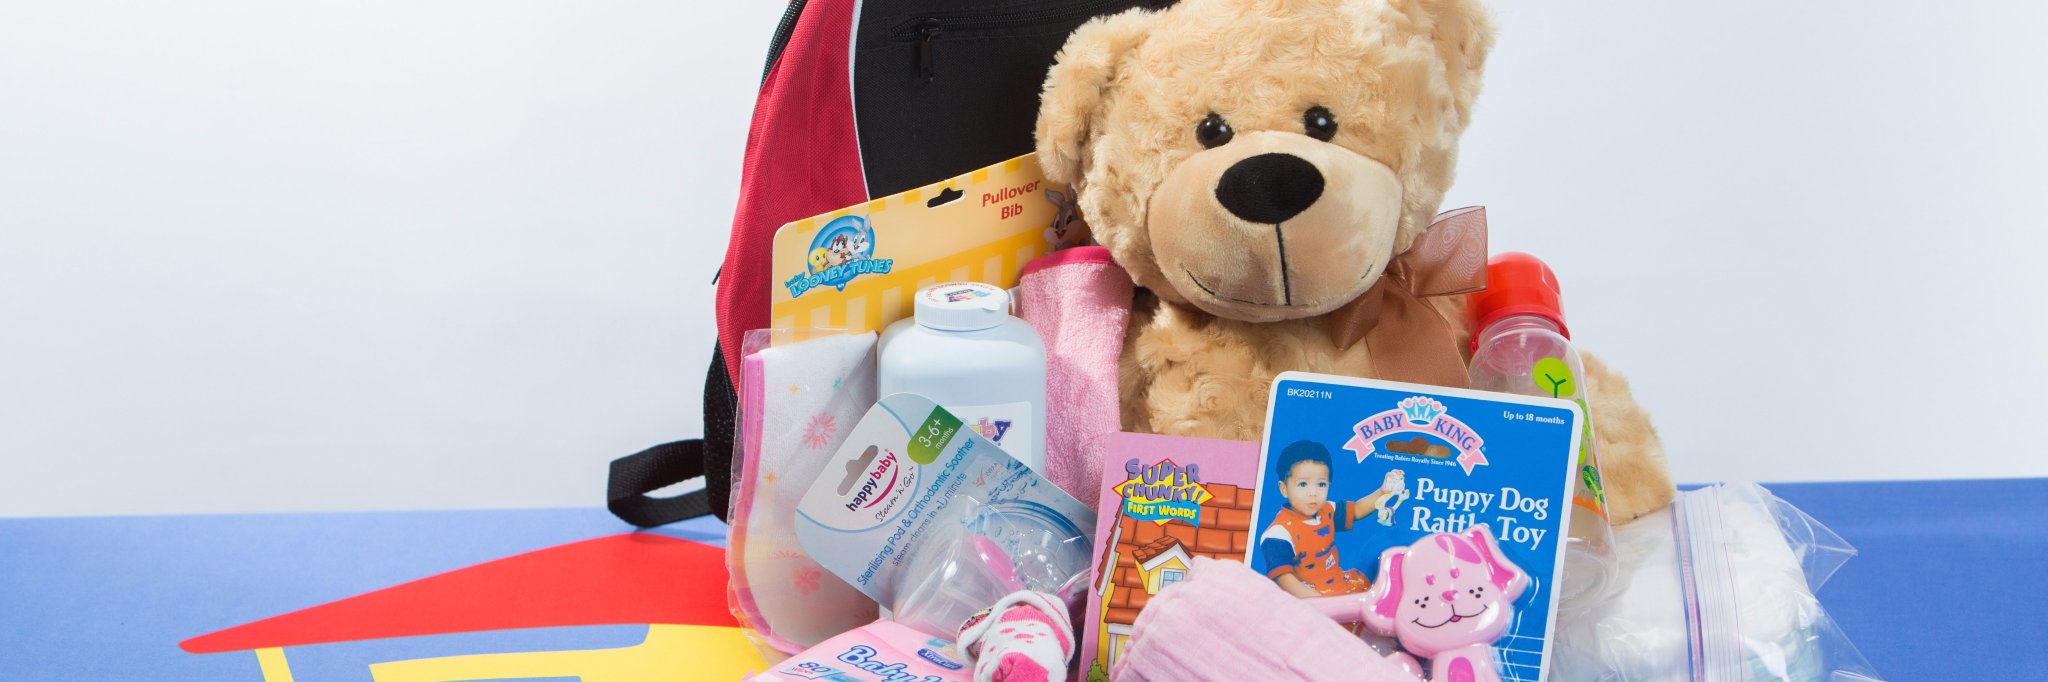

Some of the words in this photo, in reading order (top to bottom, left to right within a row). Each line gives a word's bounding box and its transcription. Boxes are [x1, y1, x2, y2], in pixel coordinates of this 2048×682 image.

[982, 180, 1040, 207] Pullover
[1001, 203, 1023, 220] Bib
[789, 264, 847, 298] LOONEY
[849, 258, 893, 274] TUNES
[1287, 388, 1332, 399] BK20211N
[1503, 410, 1514, 421] Up
[1516, 412, 1524, 420] to
[1526, 413, 1534, 421] 18
[1536, 416, 1565, 425] months
[935, 427, 954, 449] months
[1360, 413, 1403, 440] BABY
[1435, 418, 1476, 451] KING
[1374, 452, 1394, 461] Treating
[1125, 458, 1200, 486] SUPER
[1123, 483, 1205, 504] CHUNKY!
[1415, 477, 1495, 514] Puppy
[1499, 487, 1549, 521] Dog
[857, 543, 894, 586] Sterilising
[888, 526, 906, 546] Pod
[901, 518, 912, 528] &
[908, 470, 951, 519] Orthodontic
[946, 438, 975, 471] Soother
[875, 495, 898, 522] Steam
[893, 543, 911, 566] steam
[945, 472, 967, 499] minute
[1127, 502, 1156, 516] FIRST
[1159, 505, 1196, 519] WORDS
[1497, 516, 1547, 551] Toy
